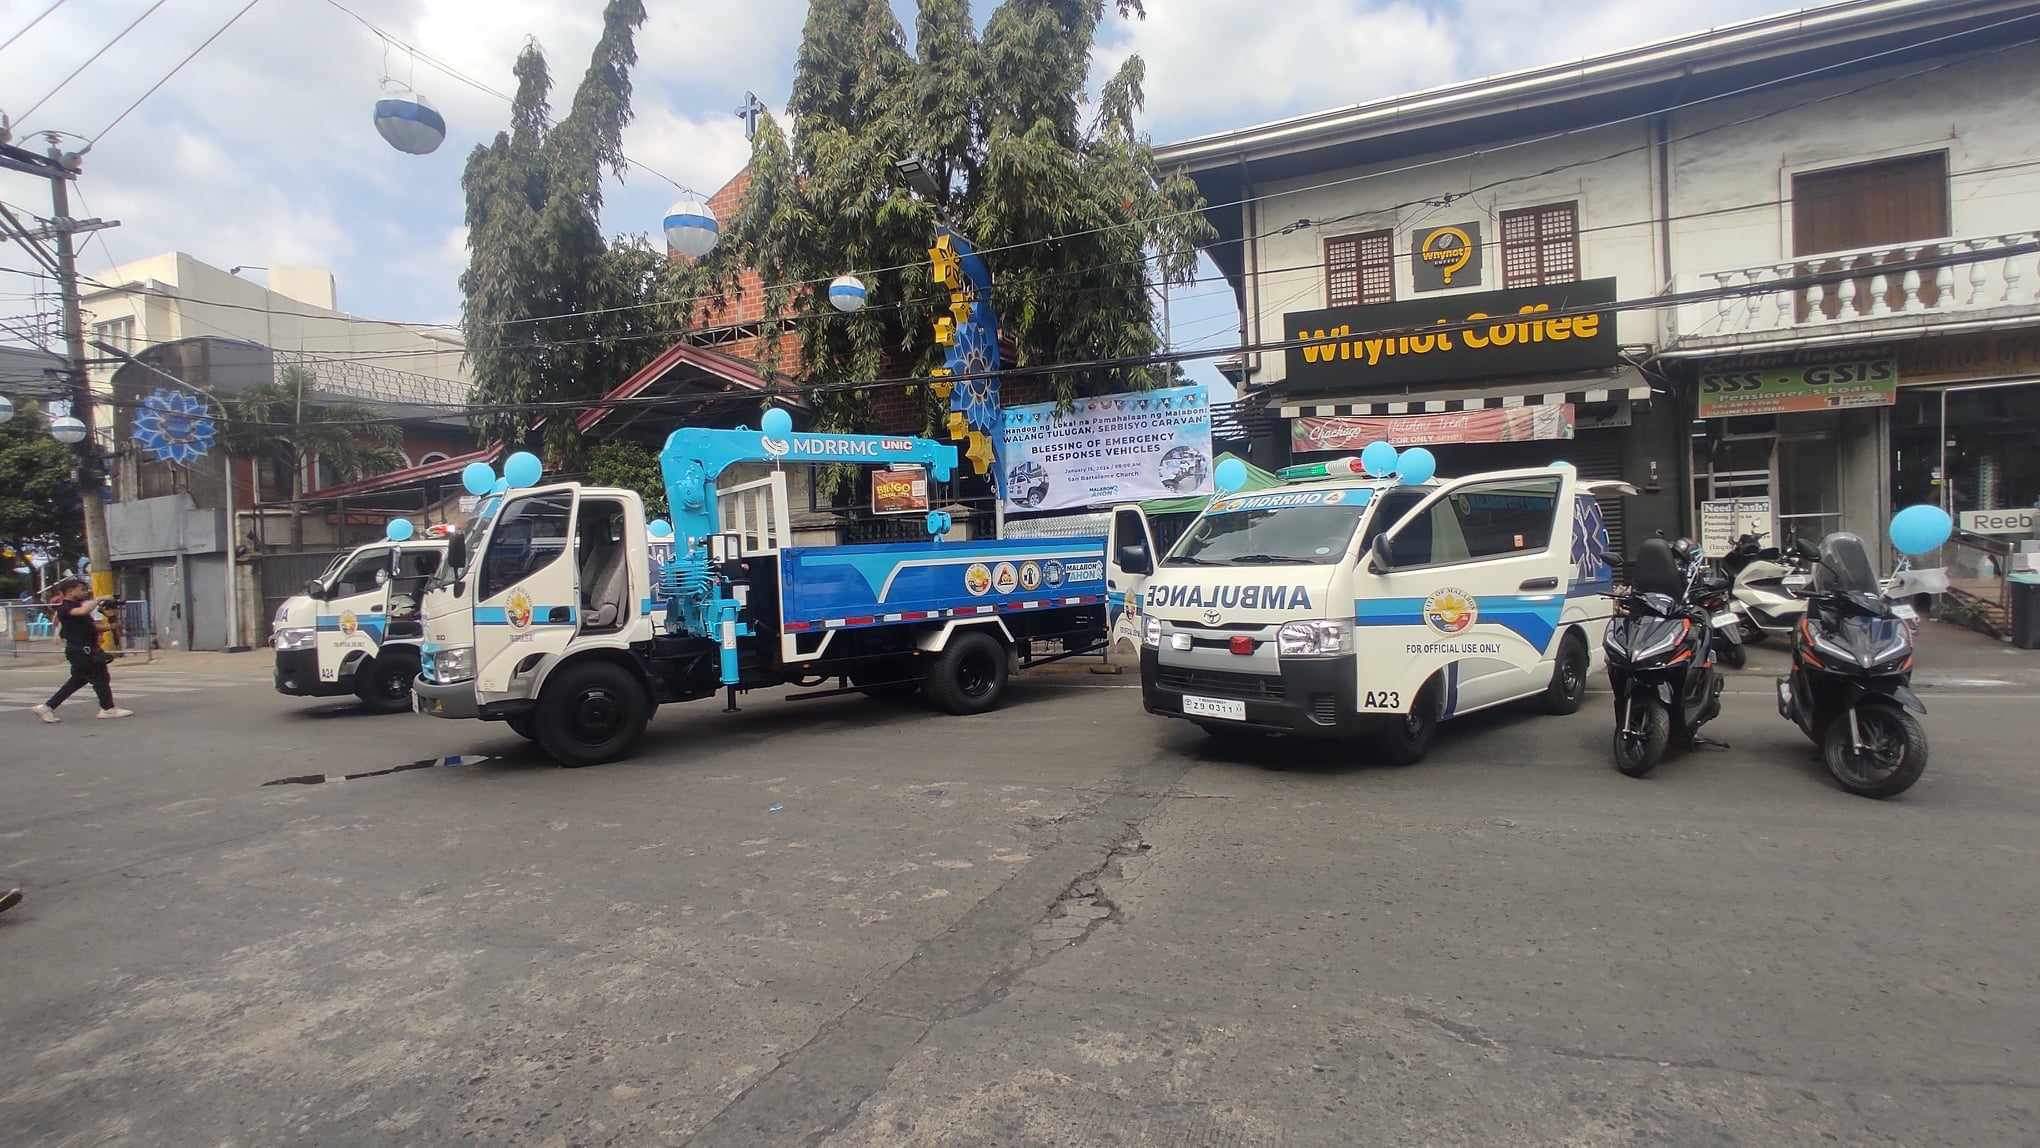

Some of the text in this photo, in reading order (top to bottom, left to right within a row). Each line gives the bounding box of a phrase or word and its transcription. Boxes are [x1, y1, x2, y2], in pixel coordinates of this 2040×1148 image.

[1299, 303, 1600, 366] Whynot Coffee
[1703, 360, 1892, 394] SSS GSIS
[1003, 431, 1044, 444] WALANG
[1098, 421, 1148, 434] SERBISYO
[882, 441, 913, 450] UNIC
[1031, 432, 1175, 455] BLESSING OF EMERGENCY
[1045, 444, 1161, 463] RESPONSE VEHICLES
[1116, 470, 1140, 478] Church
[1704, 503, 1732, 513] Need
[1406, 642, 1501, 654] FOR OFFICIAL USE ONLY
[1364, 691, 1400, 709] A23
